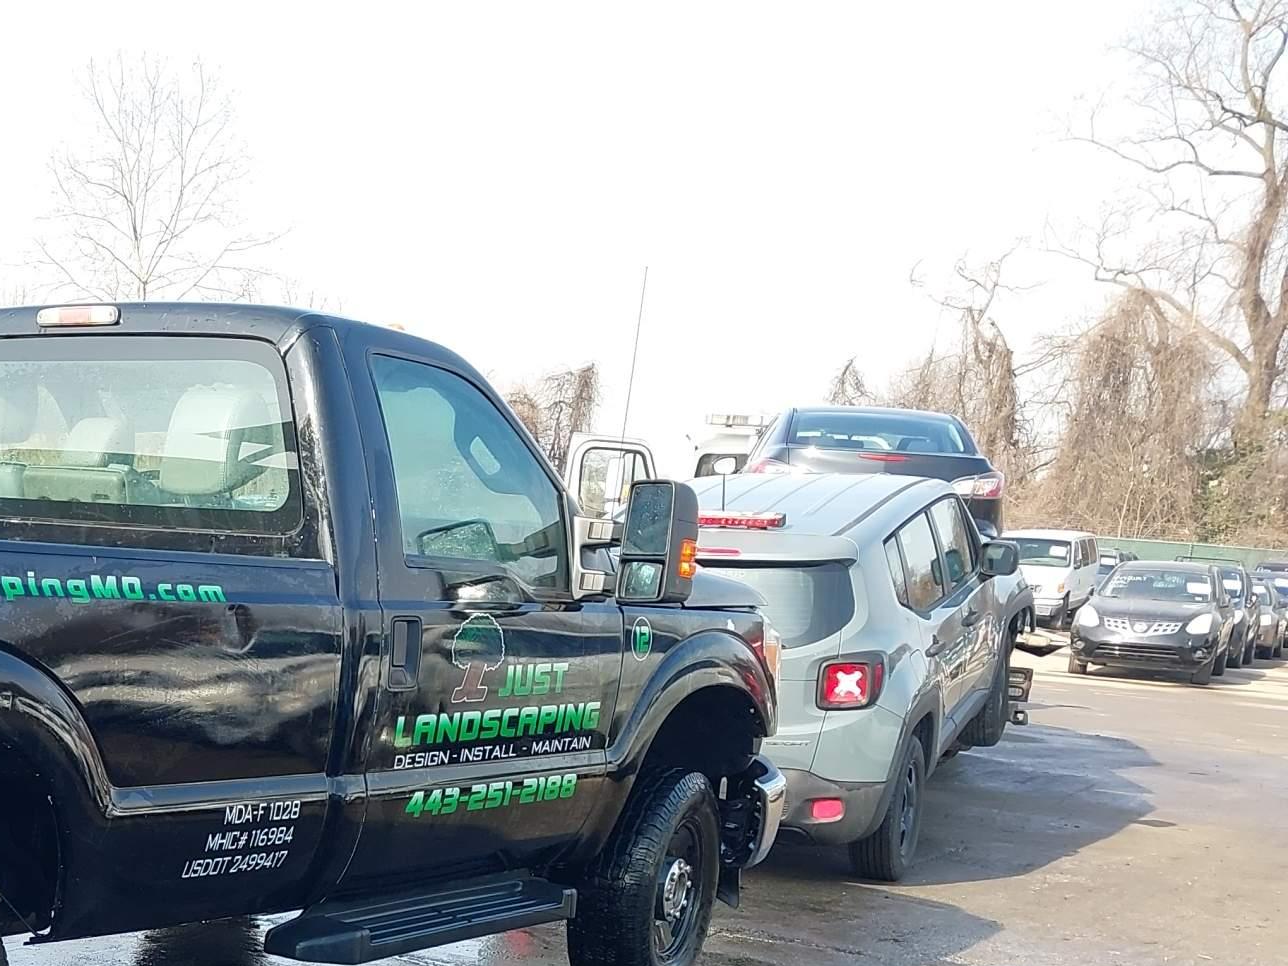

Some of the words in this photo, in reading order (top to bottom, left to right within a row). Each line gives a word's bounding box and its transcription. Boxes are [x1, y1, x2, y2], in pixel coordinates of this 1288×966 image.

[635, 625, 650, 653] 12
[498, 662, 570, 697] JUST
[393, 701, 601, 749] LANDSCAPING
[393, 749, 451, 770] DESIGN
[459, 742, 518, 763] INSTALL
[531, 735, 592, 756] MAINTAIN
[404, 772, 579, 818] 443-251-2188
[223, 802, 268, 825] MDA-F
[268, 800, 301, 821] 1028
[204, 830, 249, 853] MHIC#
[249, 825, 295, 849] 116984
[181, 856, 232, 879] USDOT
[229, 849, 289, 873] 2499417
